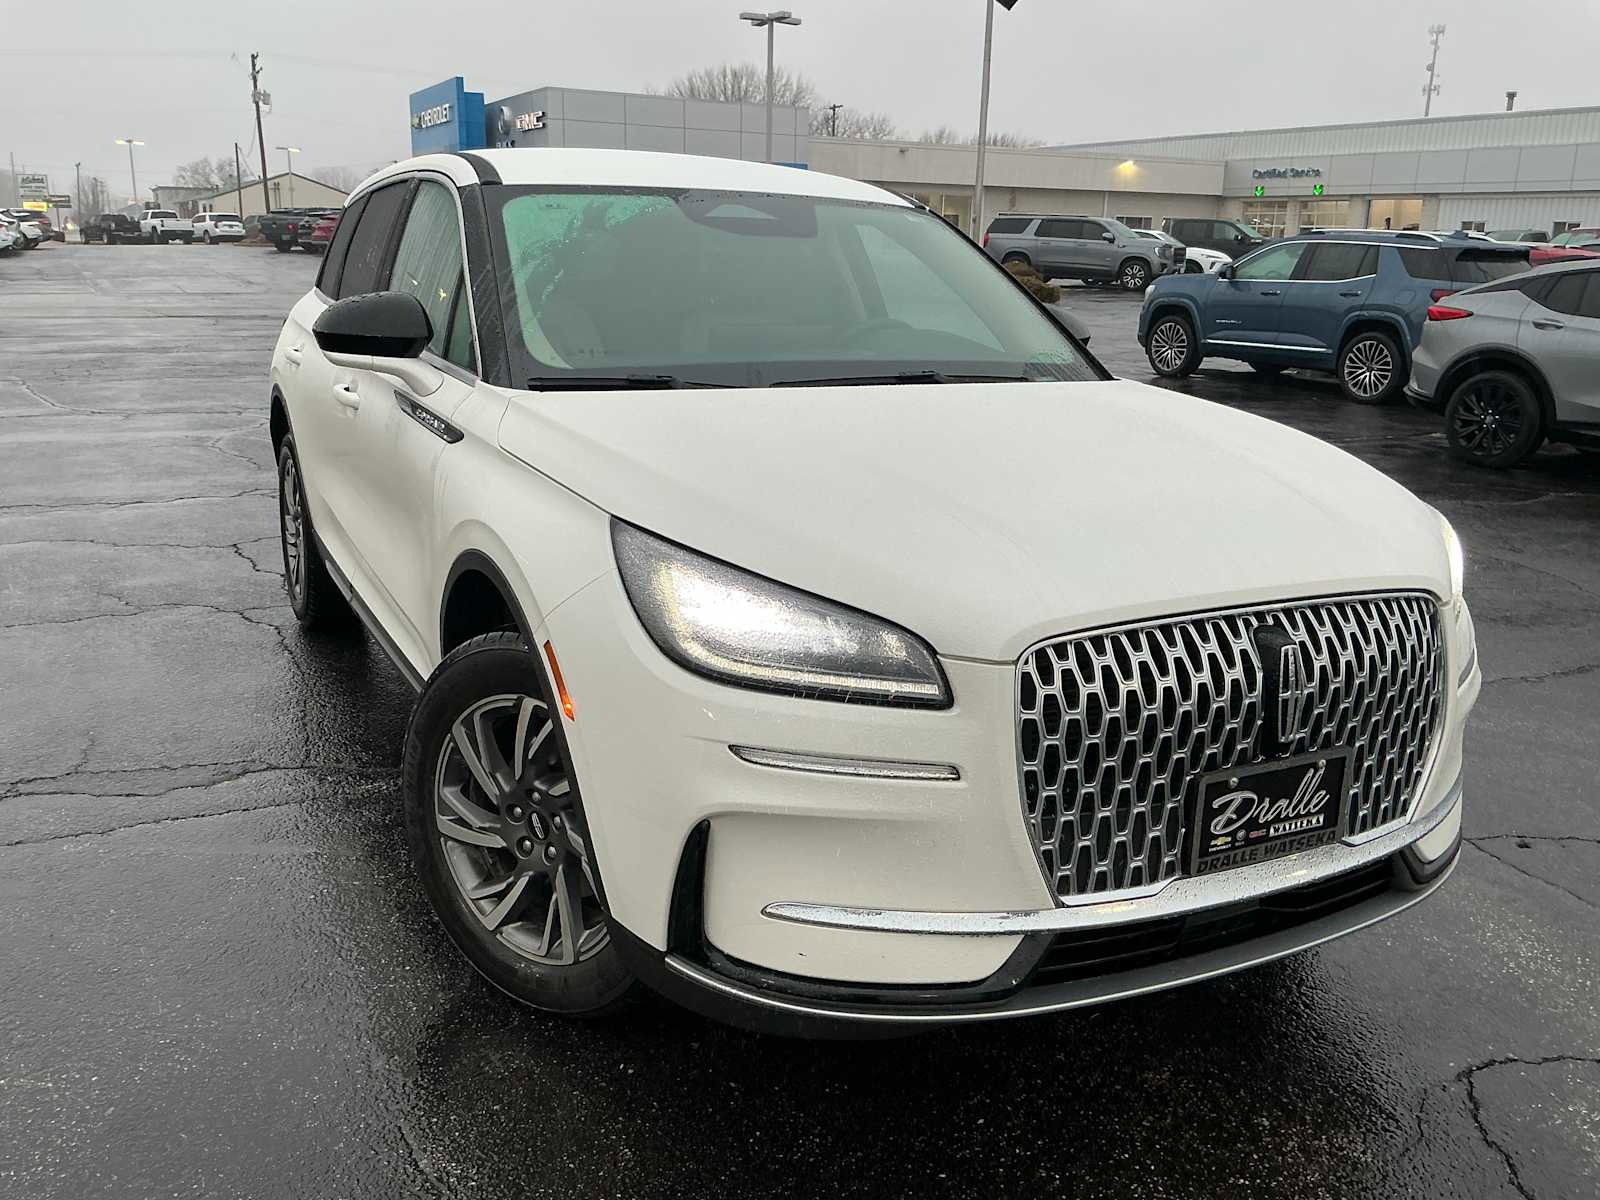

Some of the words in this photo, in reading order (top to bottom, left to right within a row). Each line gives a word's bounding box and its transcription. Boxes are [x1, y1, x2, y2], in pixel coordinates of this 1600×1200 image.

[421, 103, 450, 128] CHEVROLET
[516, 111, 544, 131] GMC
[1253, 168, 1288, 178] Certified
[1290, 167, 1321, 177] Service
[1210, 767, 1330, 834] Dralle
[1196, 851, 1258, 873] DRALLE
[1263, 829, 1337, 857] WATSEKA
